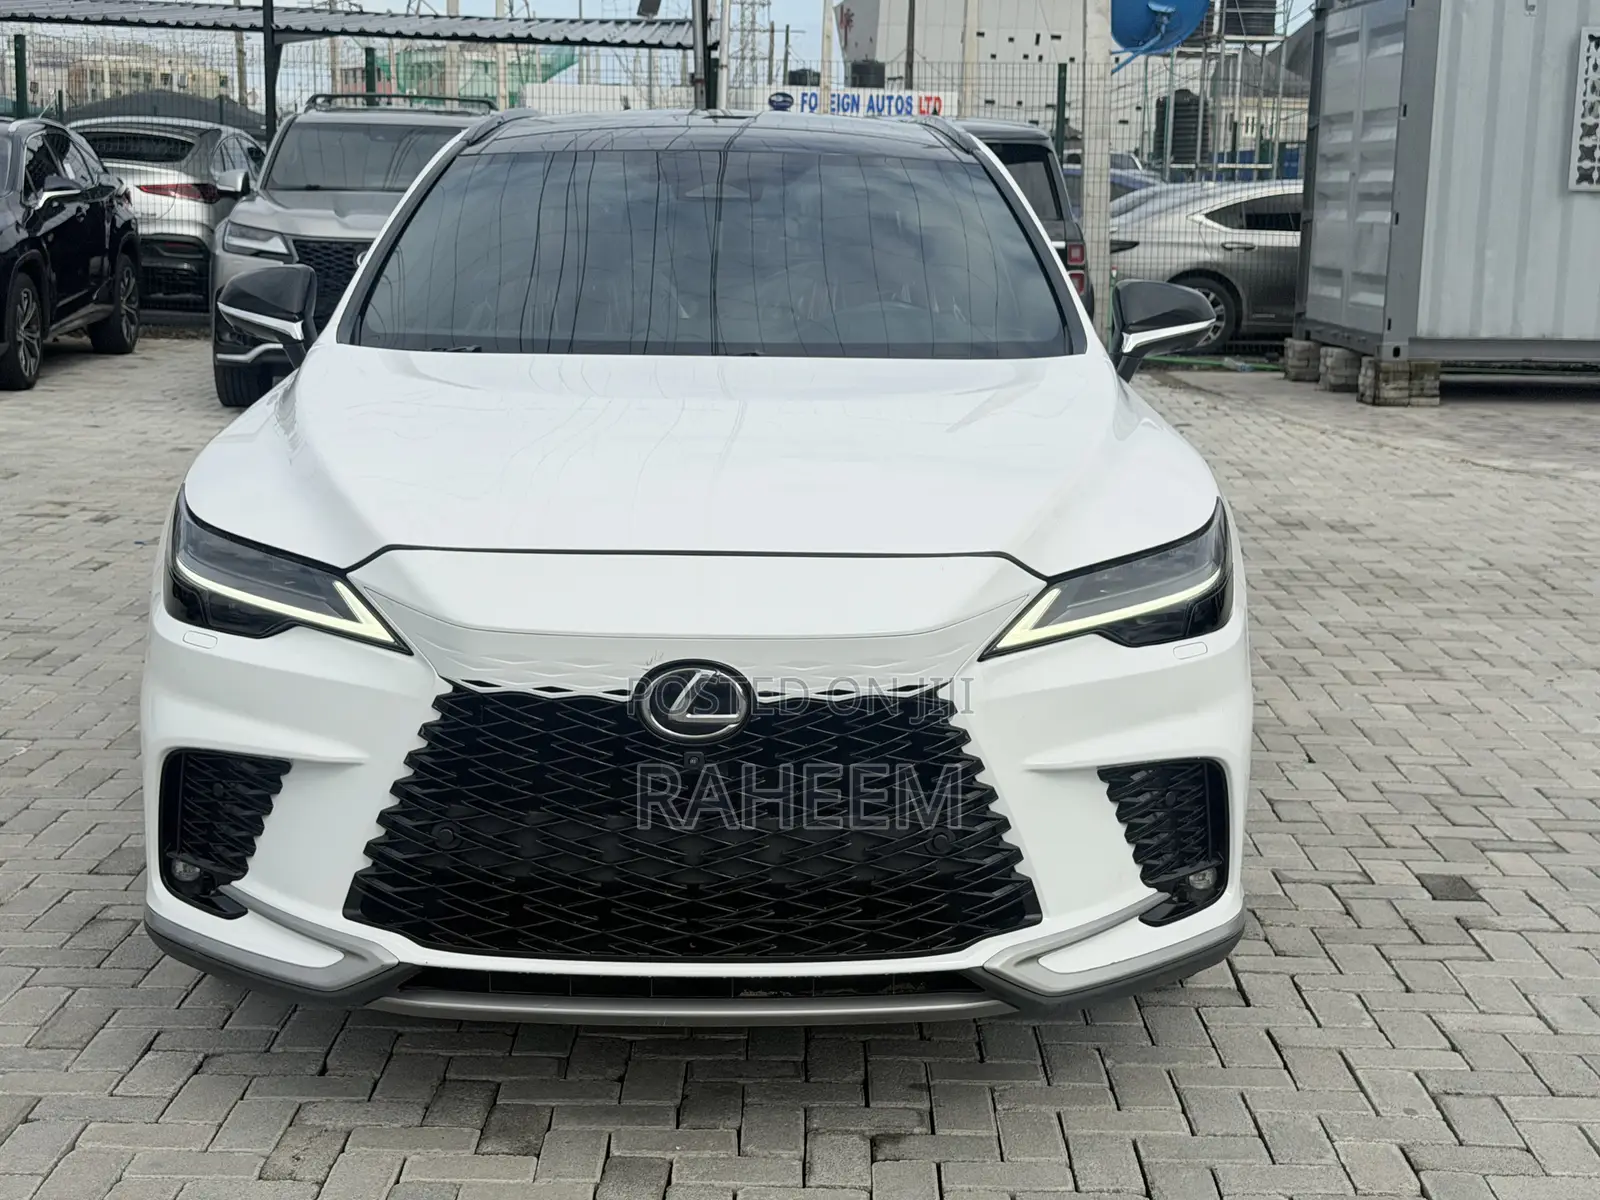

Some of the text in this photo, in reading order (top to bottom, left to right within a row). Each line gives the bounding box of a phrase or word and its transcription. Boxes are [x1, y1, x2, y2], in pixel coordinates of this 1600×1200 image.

[800, 92, 942, 116] FOEIGN AUTOS LTD
